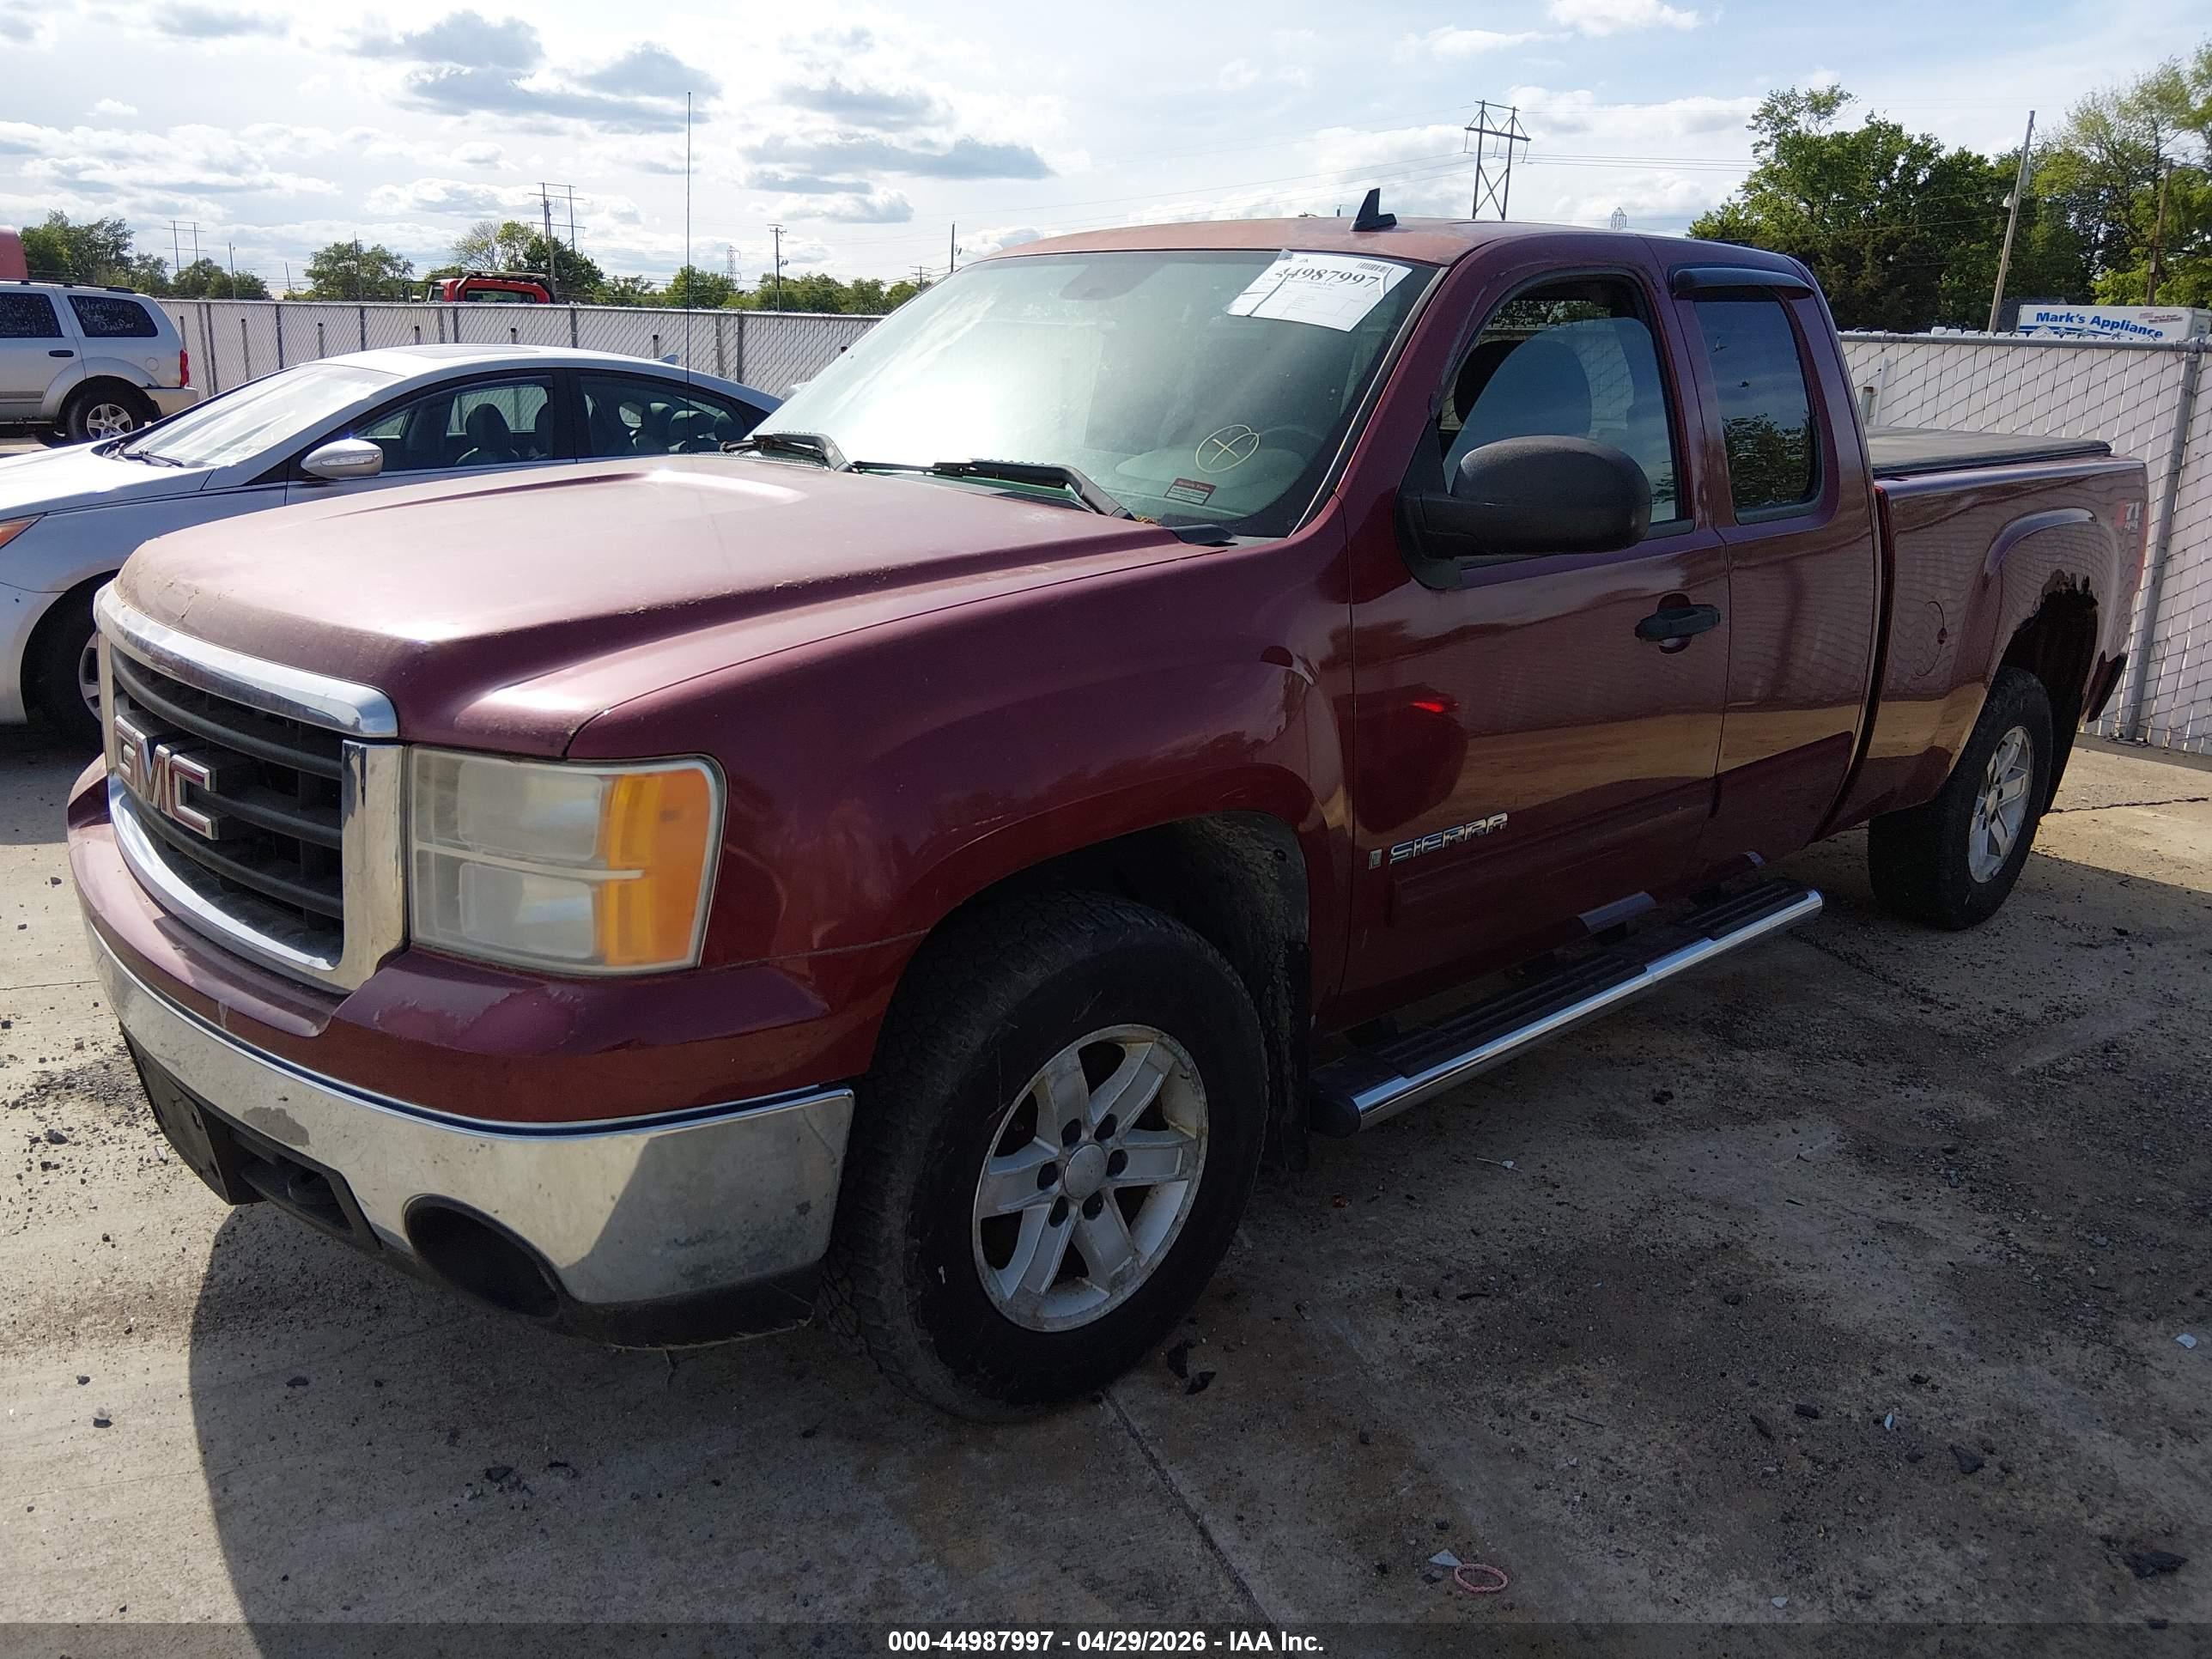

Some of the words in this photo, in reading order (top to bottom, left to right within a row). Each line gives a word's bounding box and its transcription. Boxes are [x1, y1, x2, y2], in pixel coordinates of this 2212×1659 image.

[2036, 312, 2086, 324] Mark's
[2089, 315, 2164, 338] Appliance
[114, 714, 213, 841] GMC
[1389, 812, 1508, 865] SIERRA
